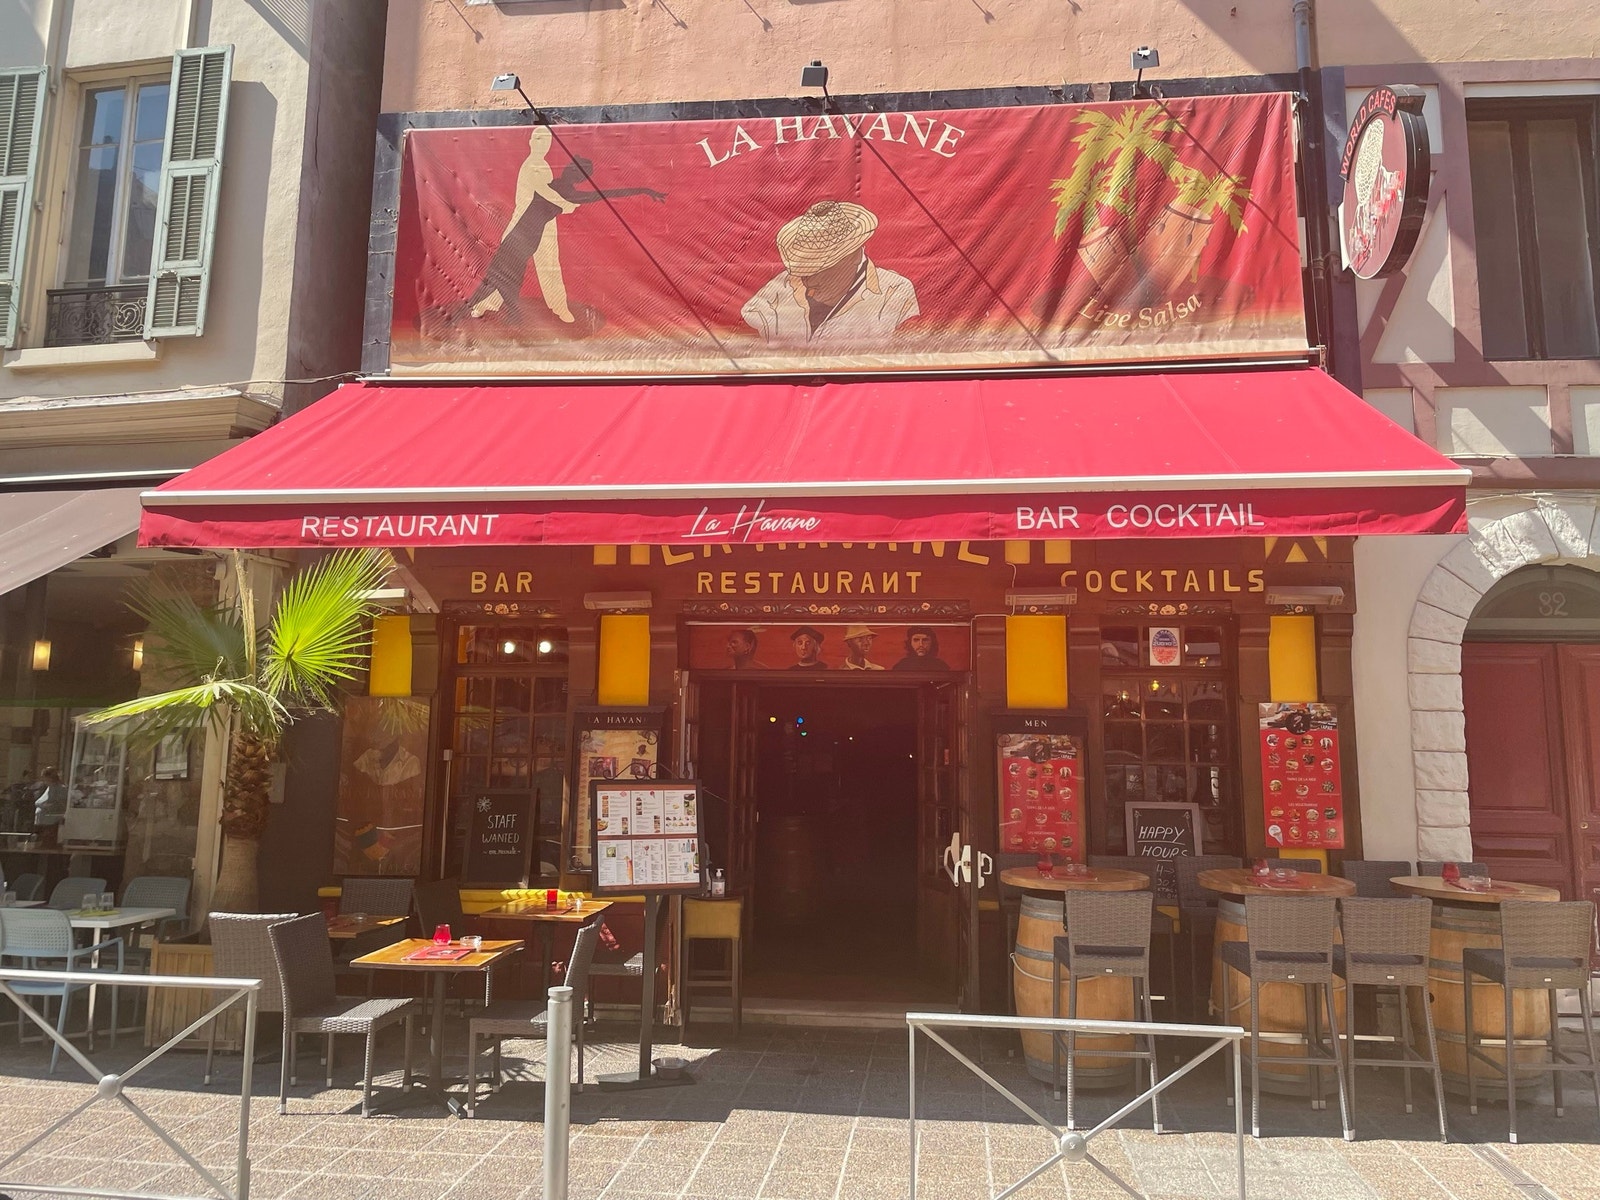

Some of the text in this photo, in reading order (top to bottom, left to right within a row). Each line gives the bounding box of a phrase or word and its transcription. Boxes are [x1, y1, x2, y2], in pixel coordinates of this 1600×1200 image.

[696, 112, 966, 168] LA HAVANE
[1341, 89, 1396, 175] WORLD CAFES
[1079, 294, 1202, 329] Live Salsa
[300, 513, 500, 538] RESTAURANT
[681, 499, 822, 543] La Havane
[1016, 503, 1265, 530] BAR COCKTAIL
[471, 571, 534, 594] BAR
[1060, 569, 1265, 593] COCKTAILS
[1539, 592, 1569, 617] 32
[487, 813, 518, 829] STAFF
[481, 832, 520, 844] WANTED
[1138, 825, 1185, 843] HAPPY
